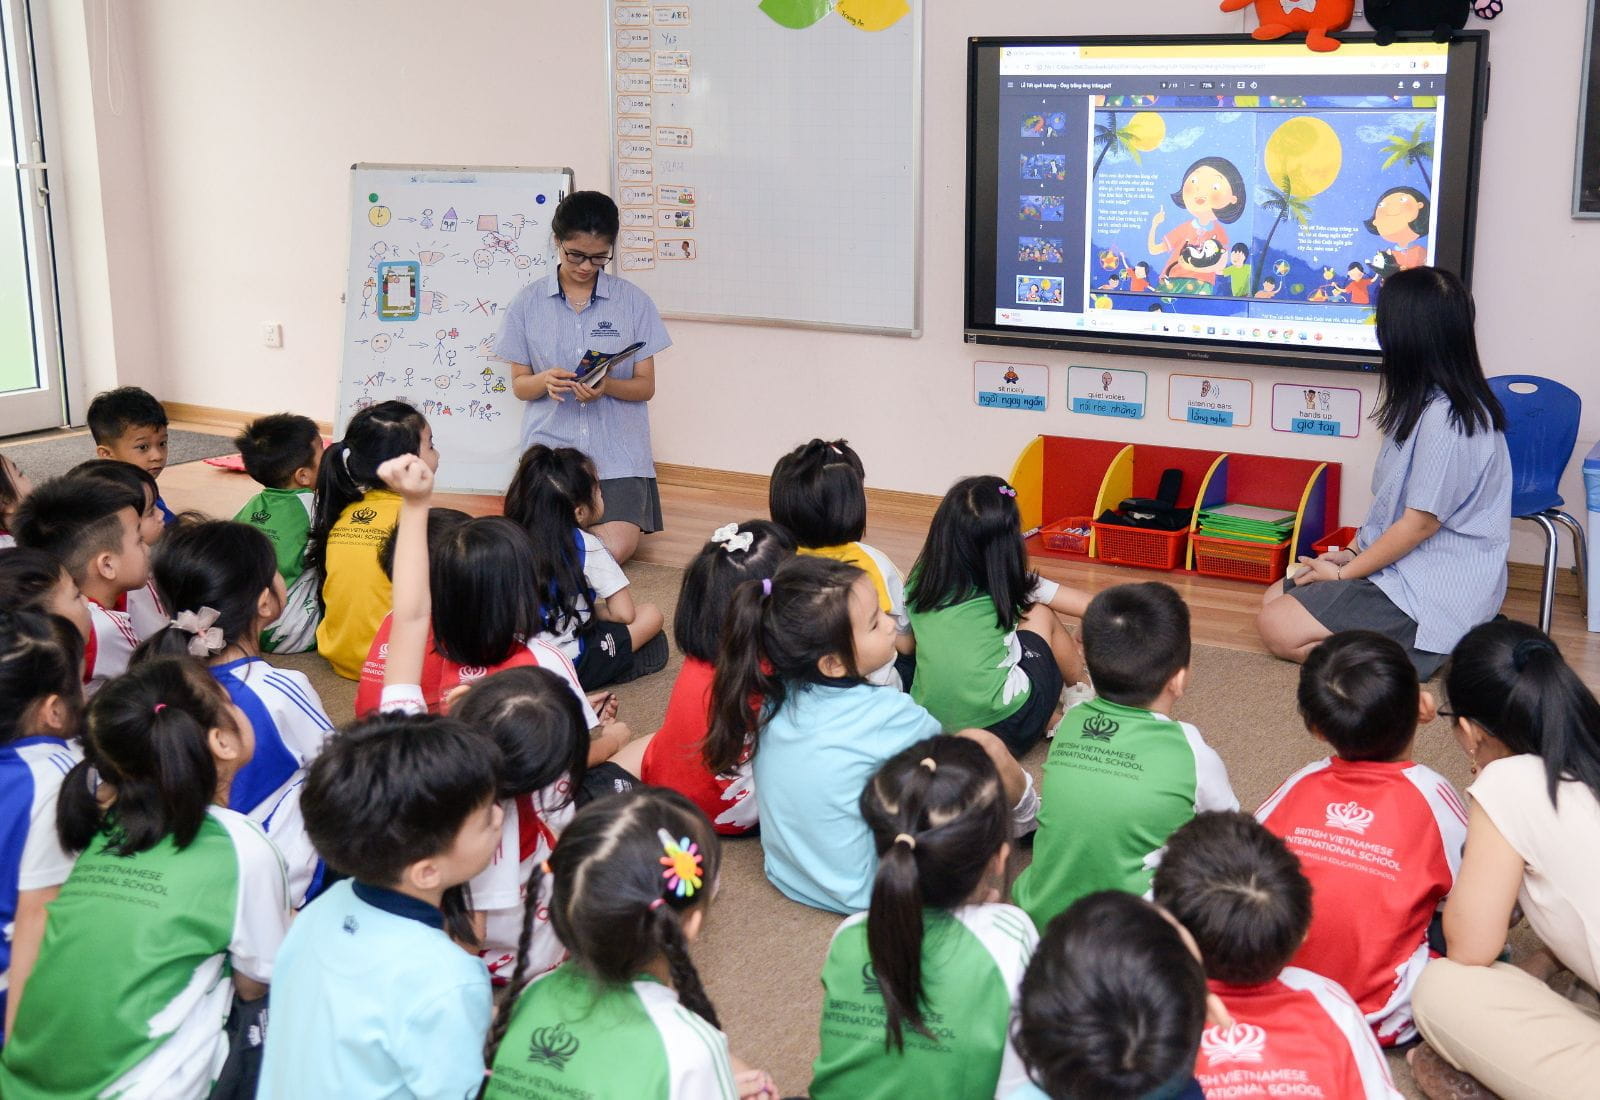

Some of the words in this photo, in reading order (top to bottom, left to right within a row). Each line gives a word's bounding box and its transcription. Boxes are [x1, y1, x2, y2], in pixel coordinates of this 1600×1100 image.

[1104, 393, 1126, 401] voices
[1187, 400, 1216, 410] listening
[1216, 402, 1233, 410] ears
[1299, 410, 1321, 419] hands
[1080, 744, 1137, 761] VIETNAMESE
[1104, 757, 1145, 772] SCHOOL
[1294, 827, 1329, 840] BRITISH
[1328, 833, 1395, 857] VIETNAMESE
[1328, 856, 1369, 873] EDUCATION
[1368, 867, 1397, 882] SCHOOL
[1358, 850, 1402, 872] SCHOOL
[120, 878, 168, 897] SCHOOL
[1222, 1068, 1310, 1085] VIETNAMESE
[1203, 1081, 1267, 1099] ATIONAL
[1267, 1081, 1325, 1098] SCHOOL
